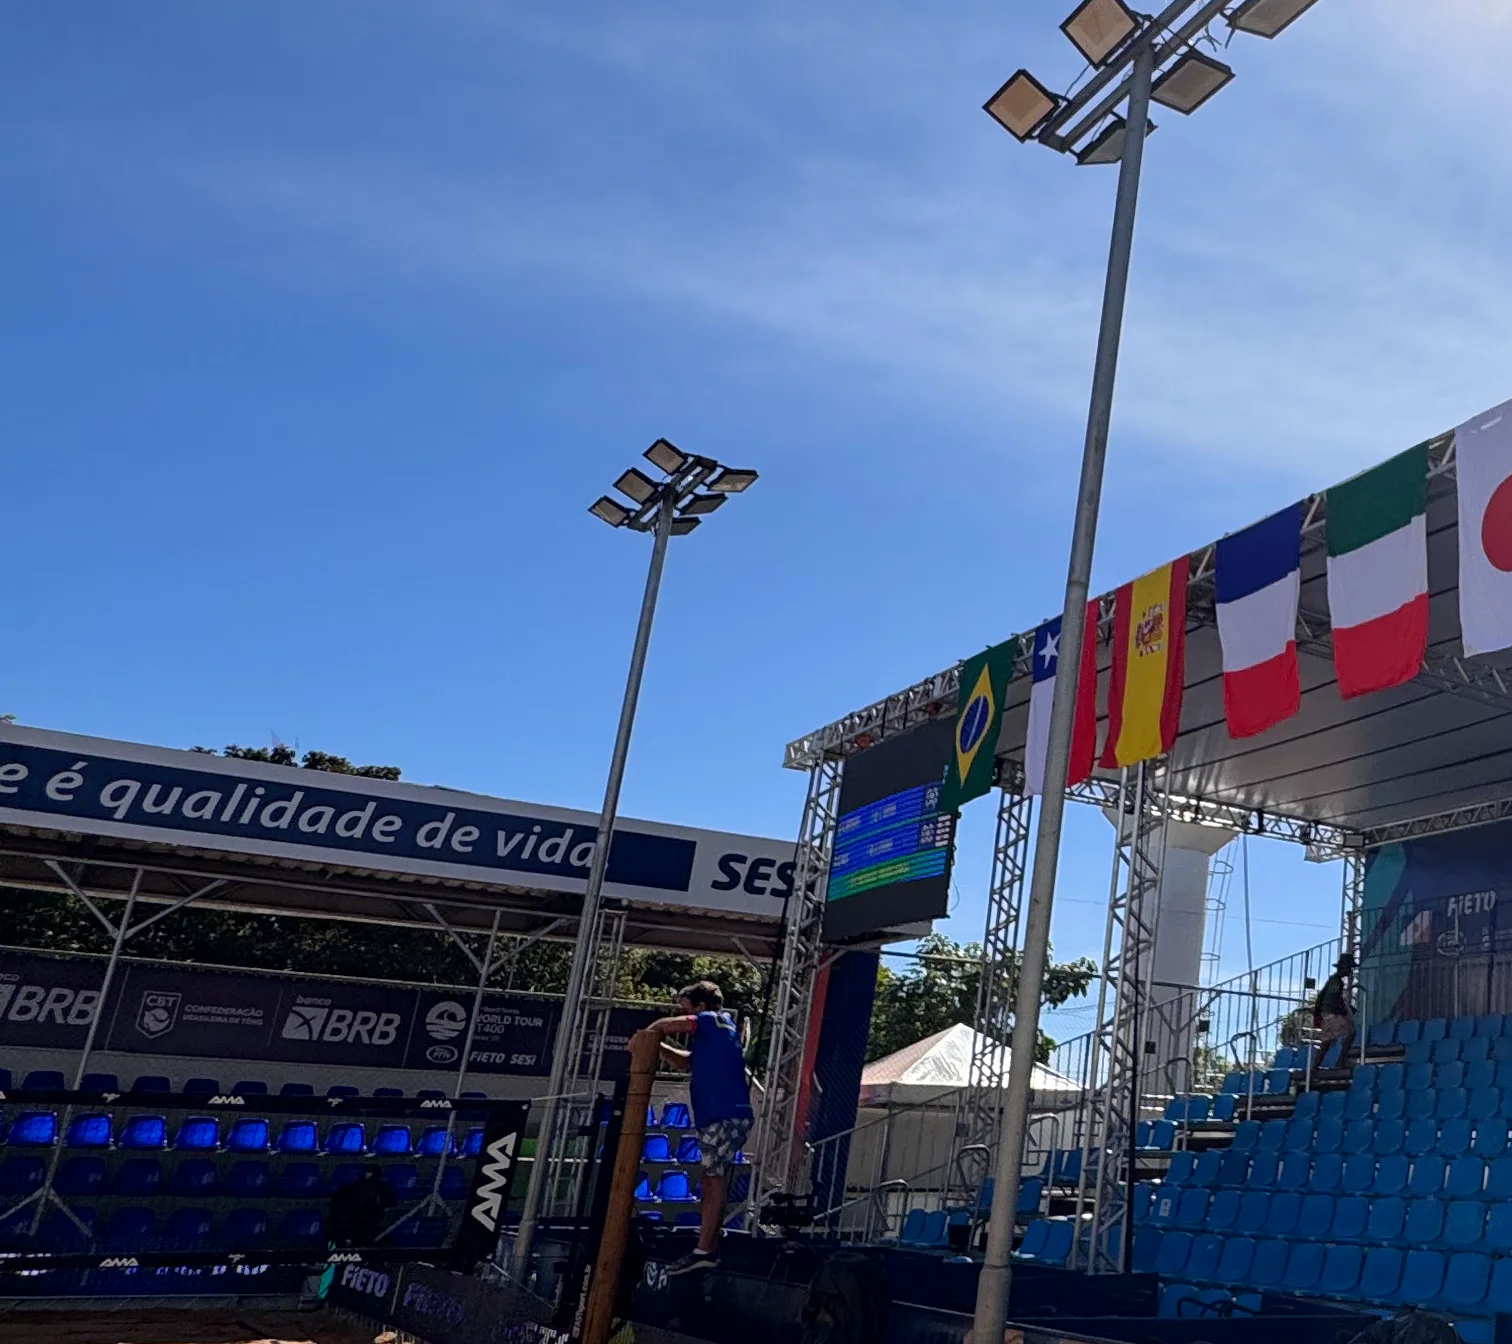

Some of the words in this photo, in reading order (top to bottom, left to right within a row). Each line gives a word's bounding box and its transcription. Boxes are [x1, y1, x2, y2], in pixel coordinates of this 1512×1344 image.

[46, 761, 88, 801] é
[100, 779, 402, 843] qualidade
[416, 812, 480, 853] de
[496, 825, 608, 869] vida
[710, 853, 798, 899] SES
[8, 985, 102, 1026] BRB
[296, 995, 332, 1007] banco
[323, 1009, 401, 1046] BRB
[477, 1023, 505, 1034] T400
